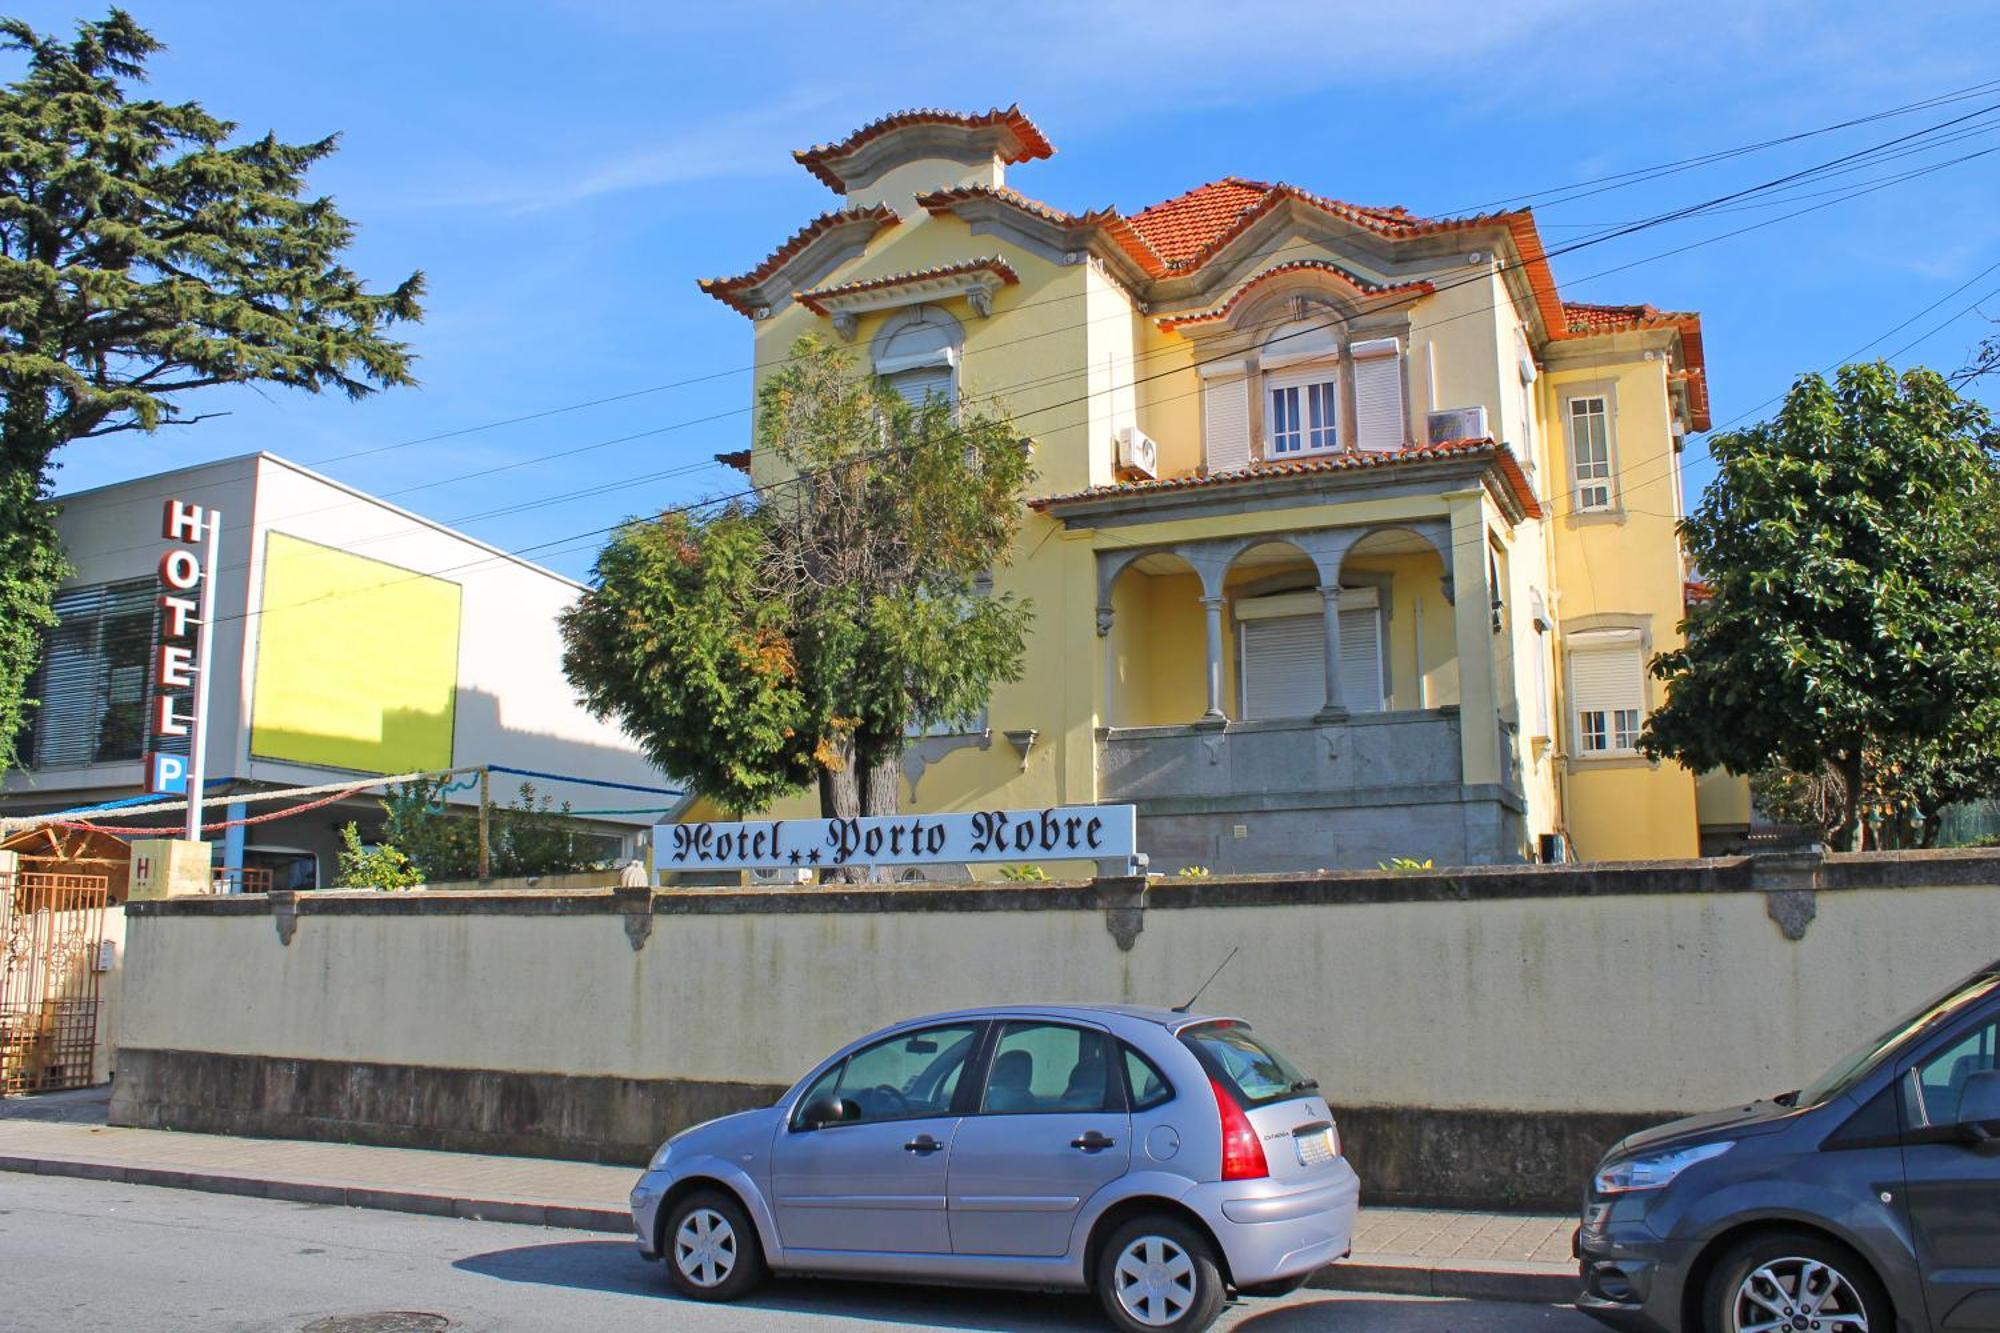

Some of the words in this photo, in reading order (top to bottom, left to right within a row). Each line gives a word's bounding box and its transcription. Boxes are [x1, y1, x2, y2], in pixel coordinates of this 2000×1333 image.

[157, 500, 203, 736] HOTEL
[158, 757, 182, 791] P
[672, 820, 784, 862] Hotel
[826, 816, 945, 865] Porto
[970, 808, 1103, 853] Nobre
[137, 857, 150, 879] H
